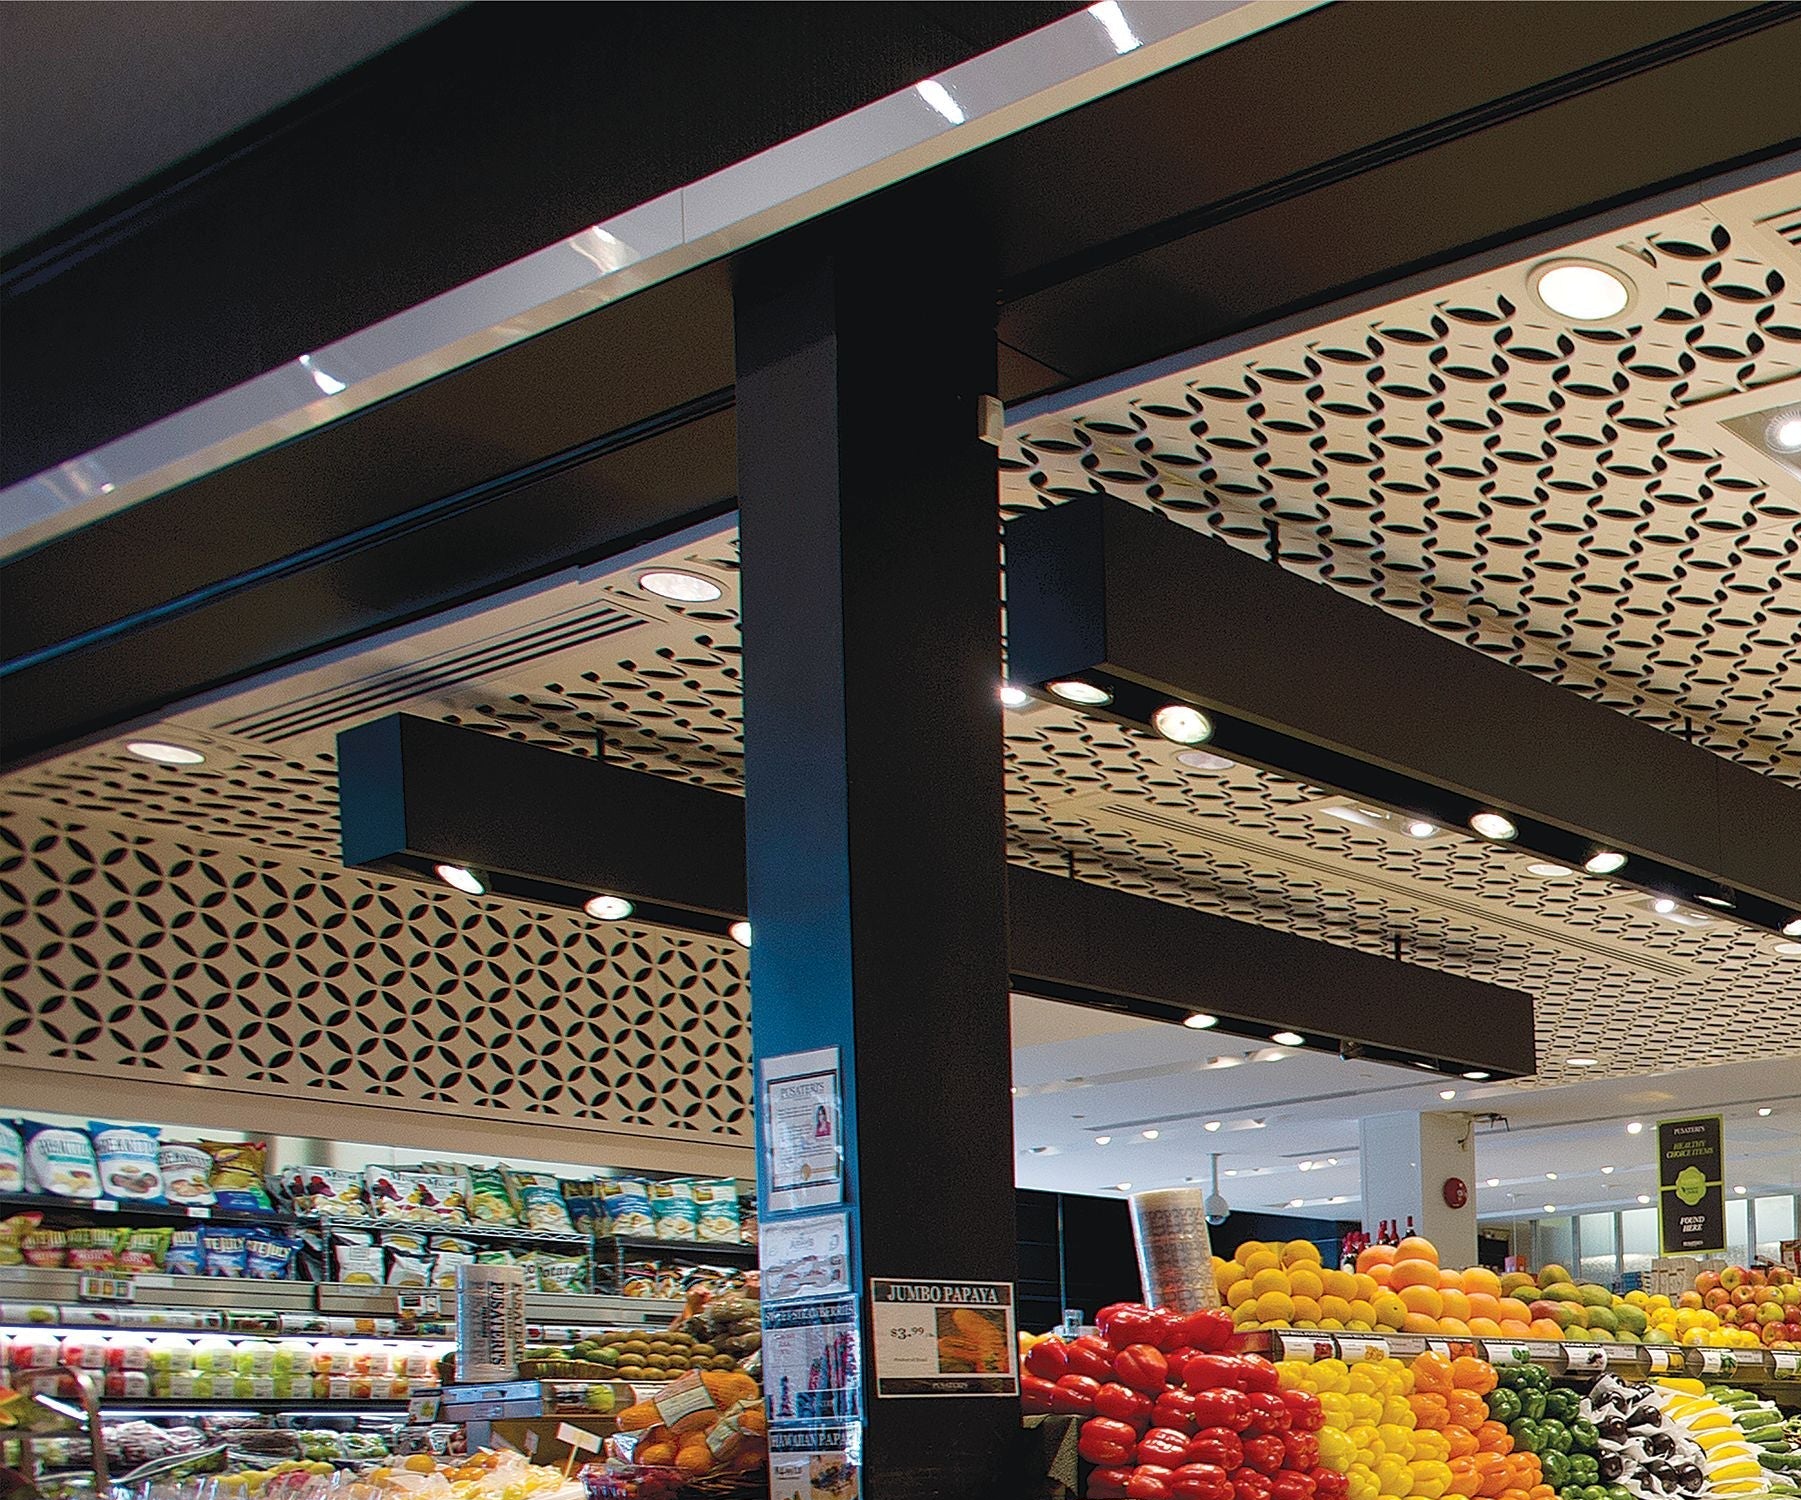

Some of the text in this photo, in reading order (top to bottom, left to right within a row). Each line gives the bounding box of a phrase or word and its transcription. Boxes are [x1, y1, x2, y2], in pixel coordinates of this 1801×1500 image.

[1680, 1216, 1705, 1225] FOUND
[1683, 1224, 1703, 1232] HERE
[887, 1284, 999, 1303] JUMBO PAPAYA
[890, 1326, 925, 1340] $3.99
[819, 1431, 856, 1447] PAPA
